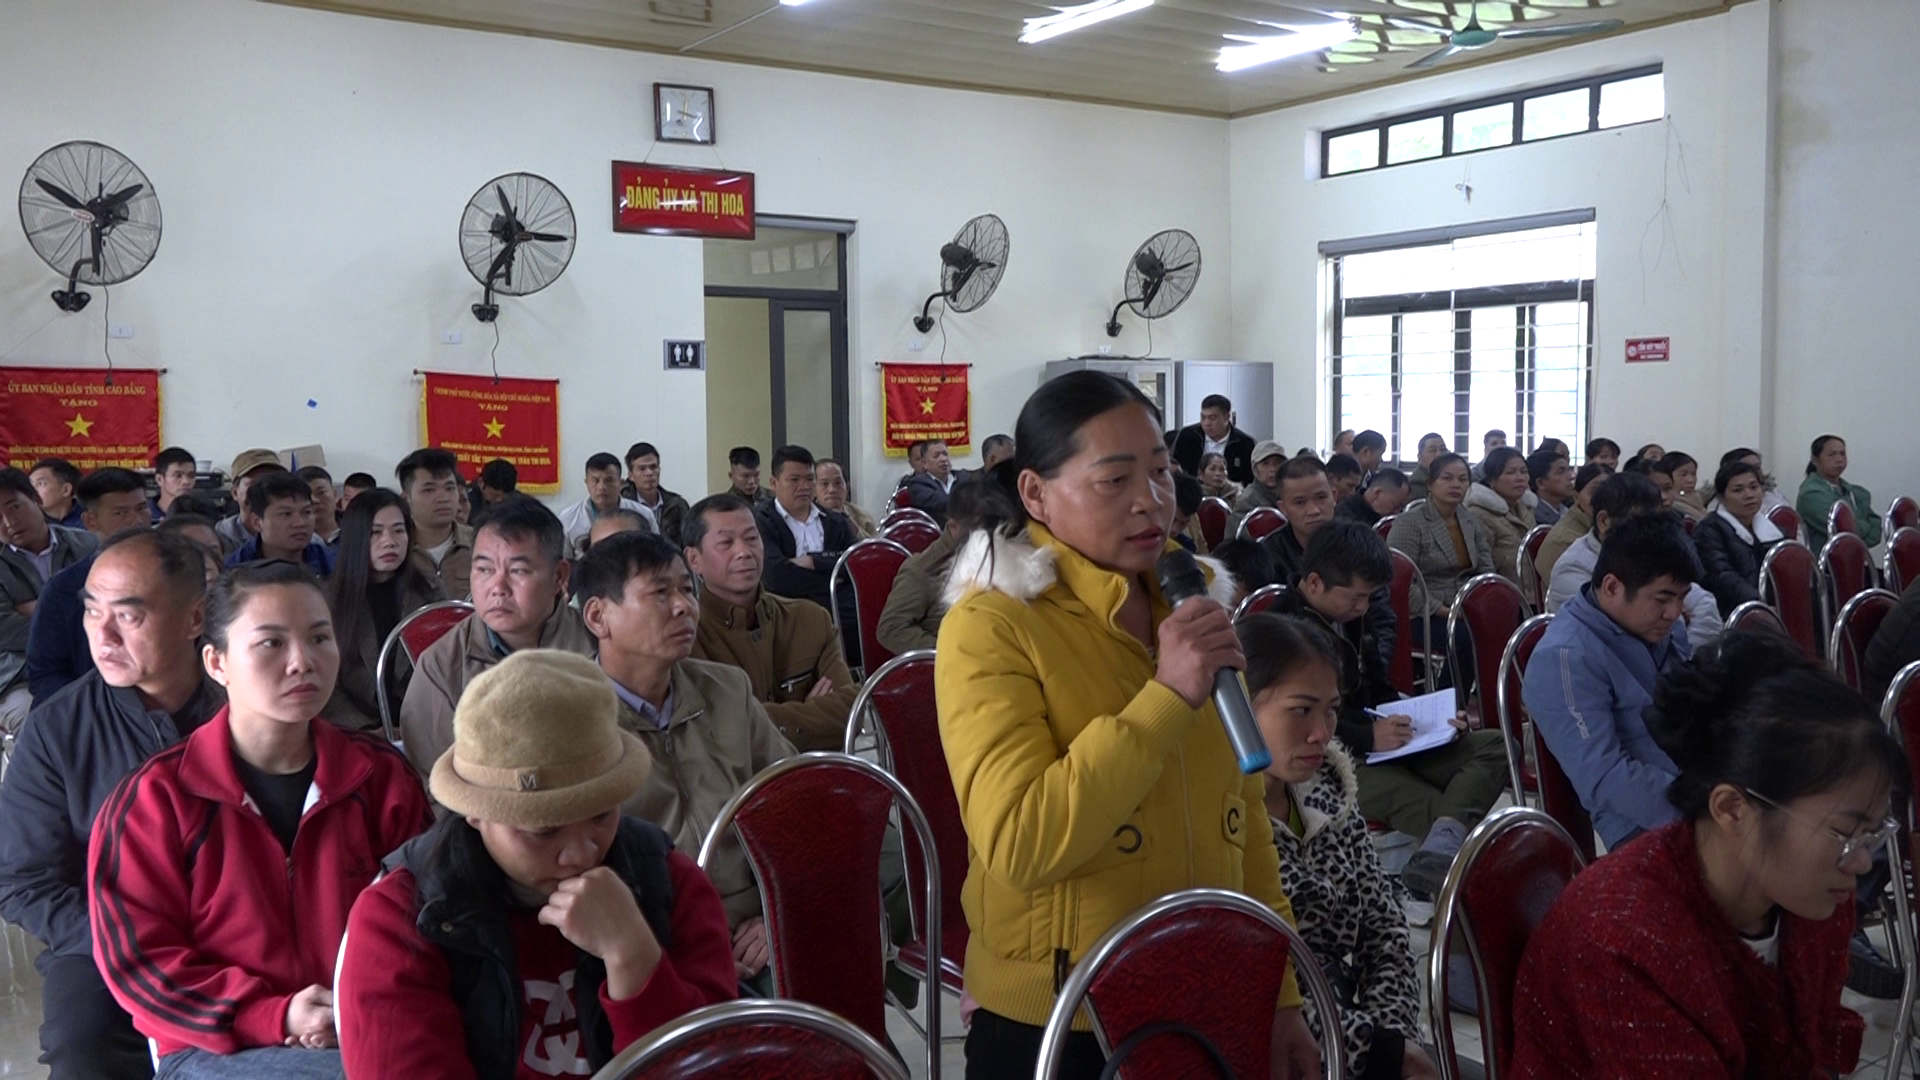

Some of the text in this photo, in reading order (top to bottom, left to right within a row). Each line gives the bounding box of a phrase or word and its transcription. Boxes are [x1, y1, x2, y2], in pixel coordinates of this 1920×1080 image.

[626, 176, 745, 219] ĐẢNG ỦY XÃ THỊ HOA
[517, 774, 538, 791] M
